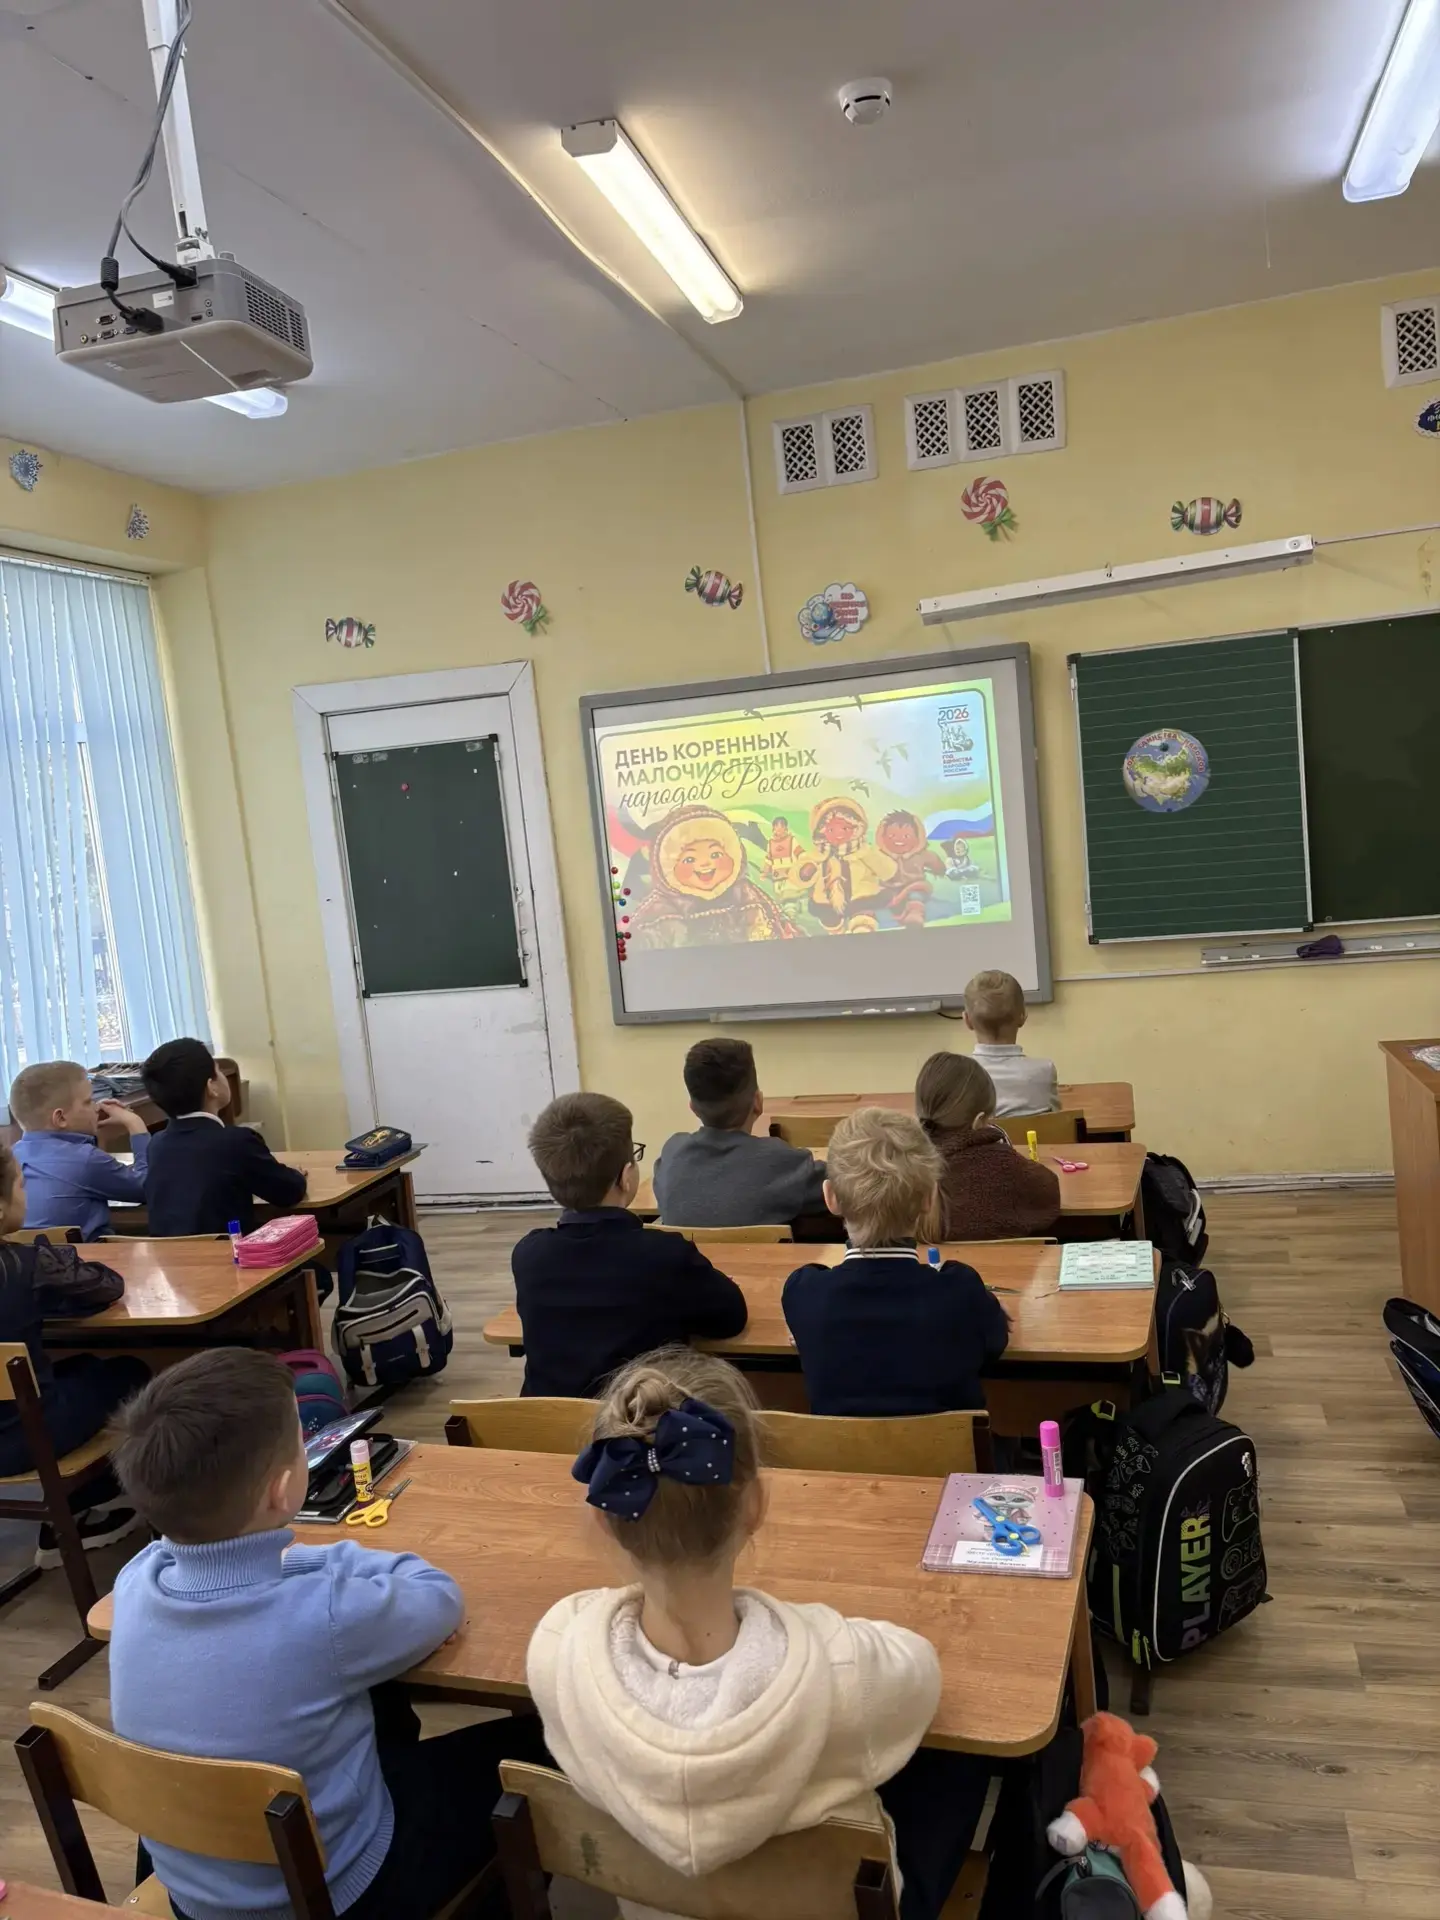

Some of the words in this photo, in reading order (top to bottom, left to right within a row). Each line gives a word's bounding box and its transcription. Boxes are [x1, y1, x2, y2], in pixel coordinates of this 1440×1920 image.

[938, 708, 969, 720] 2026
[615, 746, 668, 769] ДЕНЬ
[672, 731, 790, 761] КОРЕННЫХ
[619, 761, 723, 817] народов
[721, 761, 821, 799] России
[1180, 1513, 1211, 1650] PLAYER
